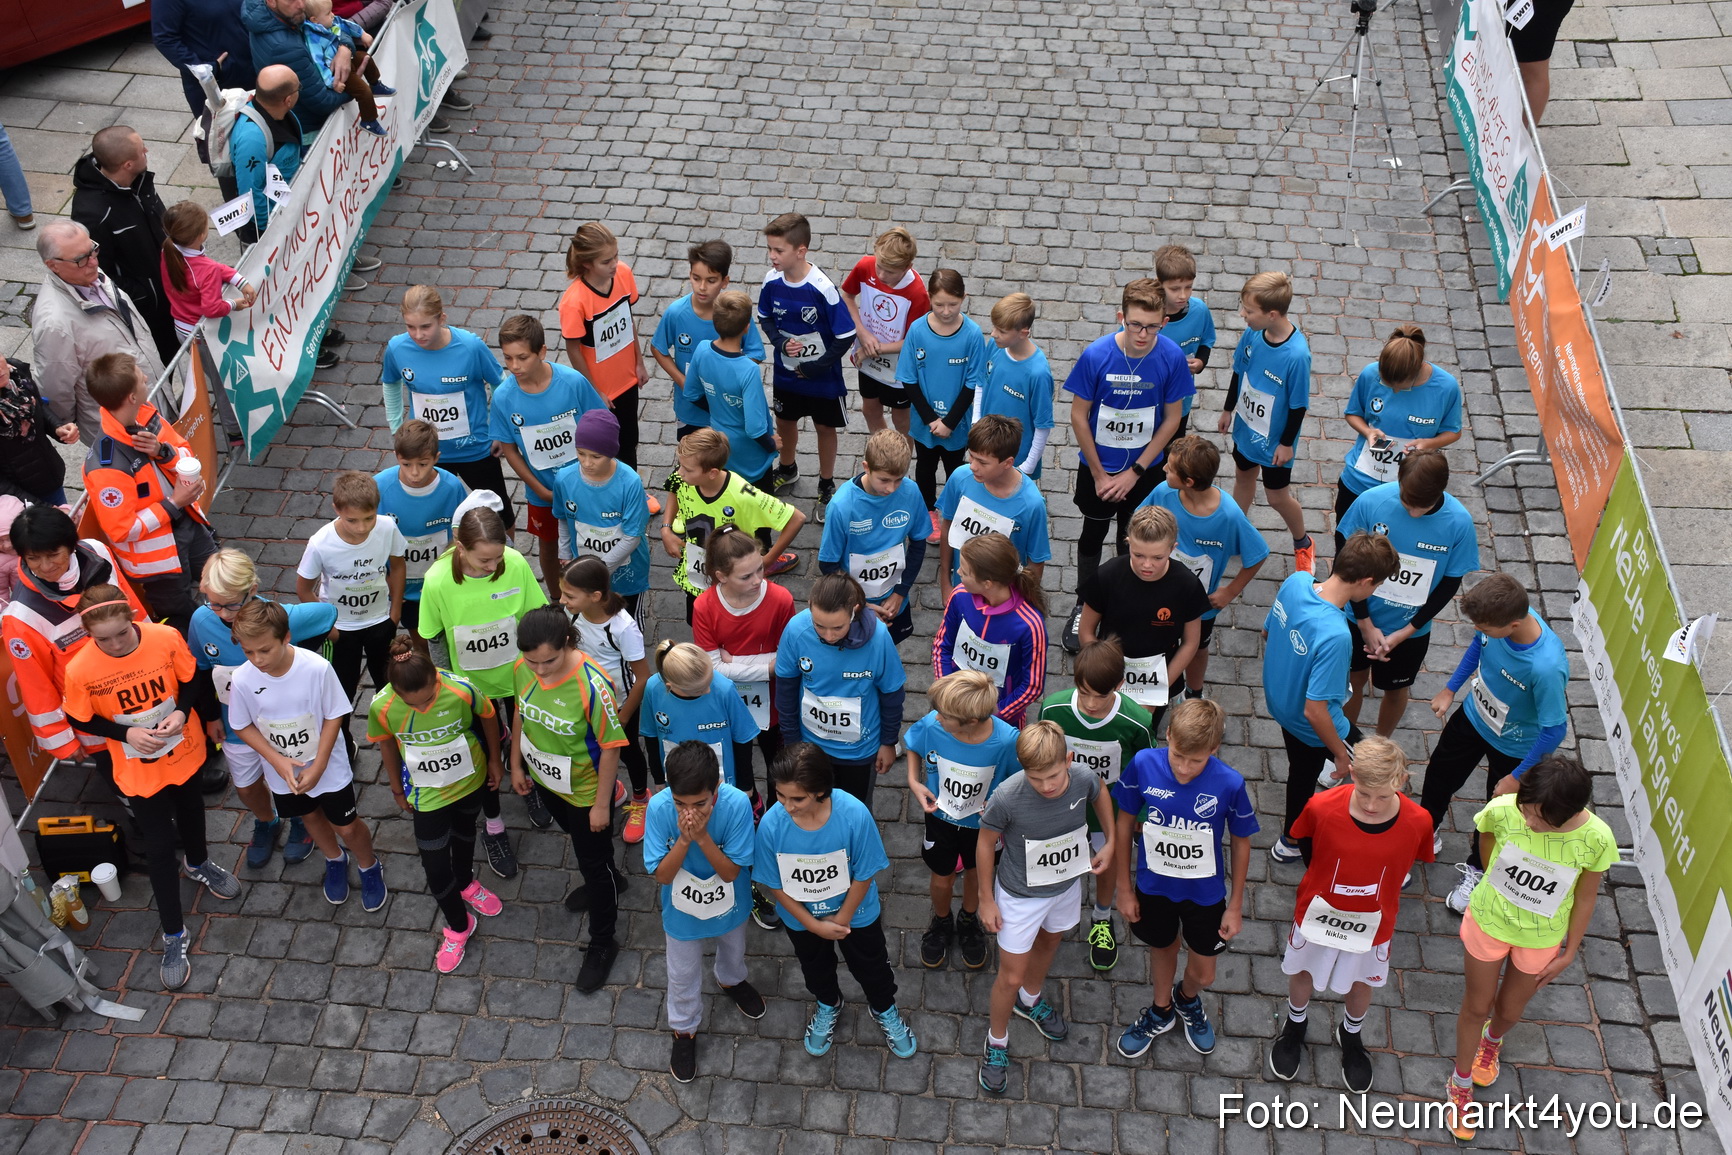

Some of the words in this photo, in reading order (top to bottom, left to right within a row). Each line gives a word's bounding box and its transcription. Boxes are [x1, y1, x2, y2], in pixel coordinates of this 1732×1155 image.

[1513, 1, 1531, 23] swn
[218, 208, 240, 226] swn
[282, 181, 320, 271] UNS
[1550, 222, 1573, 242] swn
[261, 213, 341, 371] EINFACH
[600, 317, 627, 342] 4013
[441, 375, 468, 383] BOCK
[1264, 369, 1283, 385] BOCK
[1003, 384, 1025, 400] BOCK
[933, 400, 946, 410] 18.
[1242, 391, 1265, 418] 4016
[422, 406, 459, 423] 4029
[551, 408, 577, 422] BOCK
[1408, 415, 1436, 425] BOCK
[1105, 420, 1144, 434] 4011
[534, 430, 573, 452] 4008
[549, 451, 566, 460] Lukas
[427, 517, 451, 527] BOCK
[1195, 538, 1223, 548] BOCK
[1417, 542, 1448, 552] BOCK
[403, 546, 438, 563] 4041
[1632, 528, 1650, 577] Der
[353, 558, 373, 567] Hier
[859, 561, 898, 582] 4037
[332, 571, 372, 580] werden
[1389, 569, 1423, 586] 097
[337, 590, 380, 608] 4007
[466, 632, 510, 653] 4043
[961, 641, 999, 670] 4019
[103, 677, 120, 687] SPORT
[120, 671, 137, 681] VIBES
[842, 670, 873, 678] BOCK
[1125, 671, 1160, 686] 044
[1501, 668, 1526, 691] BOCK
[116, 675, 167, 709] RUN
[590, 674, 621, 730] BOCK
[697, 720, 727, 730] BOCK
[809, 706, 851, 727] 4015
[269, 728, 310, 749] 4045
[395, 718, 464, 744] BOCK
[1662, 701, 1683, 764] wo's
[417, 753, 462, 773] 4039
[526, 752, 562, 781] 4038
[943, 777, 983, 800] 4099
[1638, 698, 1696, 875] langgeht!
[344, 806, 356, 817] JAKO
[1168, 814, 1211, 831] JAKO
[1036, 843, 1080, 867] 4001
[1154, 841, 1204, 860] 4005
[790, 864, 839, 884] 4028
[1163, 860, 1198, 871] Alexander
[803, 885, 831, 894] Radwan
[1504, 865, 1558, 896] 4004
[681, 885, 726, 905] 4033
[1345, 887, 1366, 895] DEHN
[1504, 880, 1520, 897] Luca
[1519, 892, 1542, 906] Ronja
[812, 901, 831, 911] 18.
[1314, 913, 1367, 934] 4000
[1325, 929, 1348, 941] Niklas
